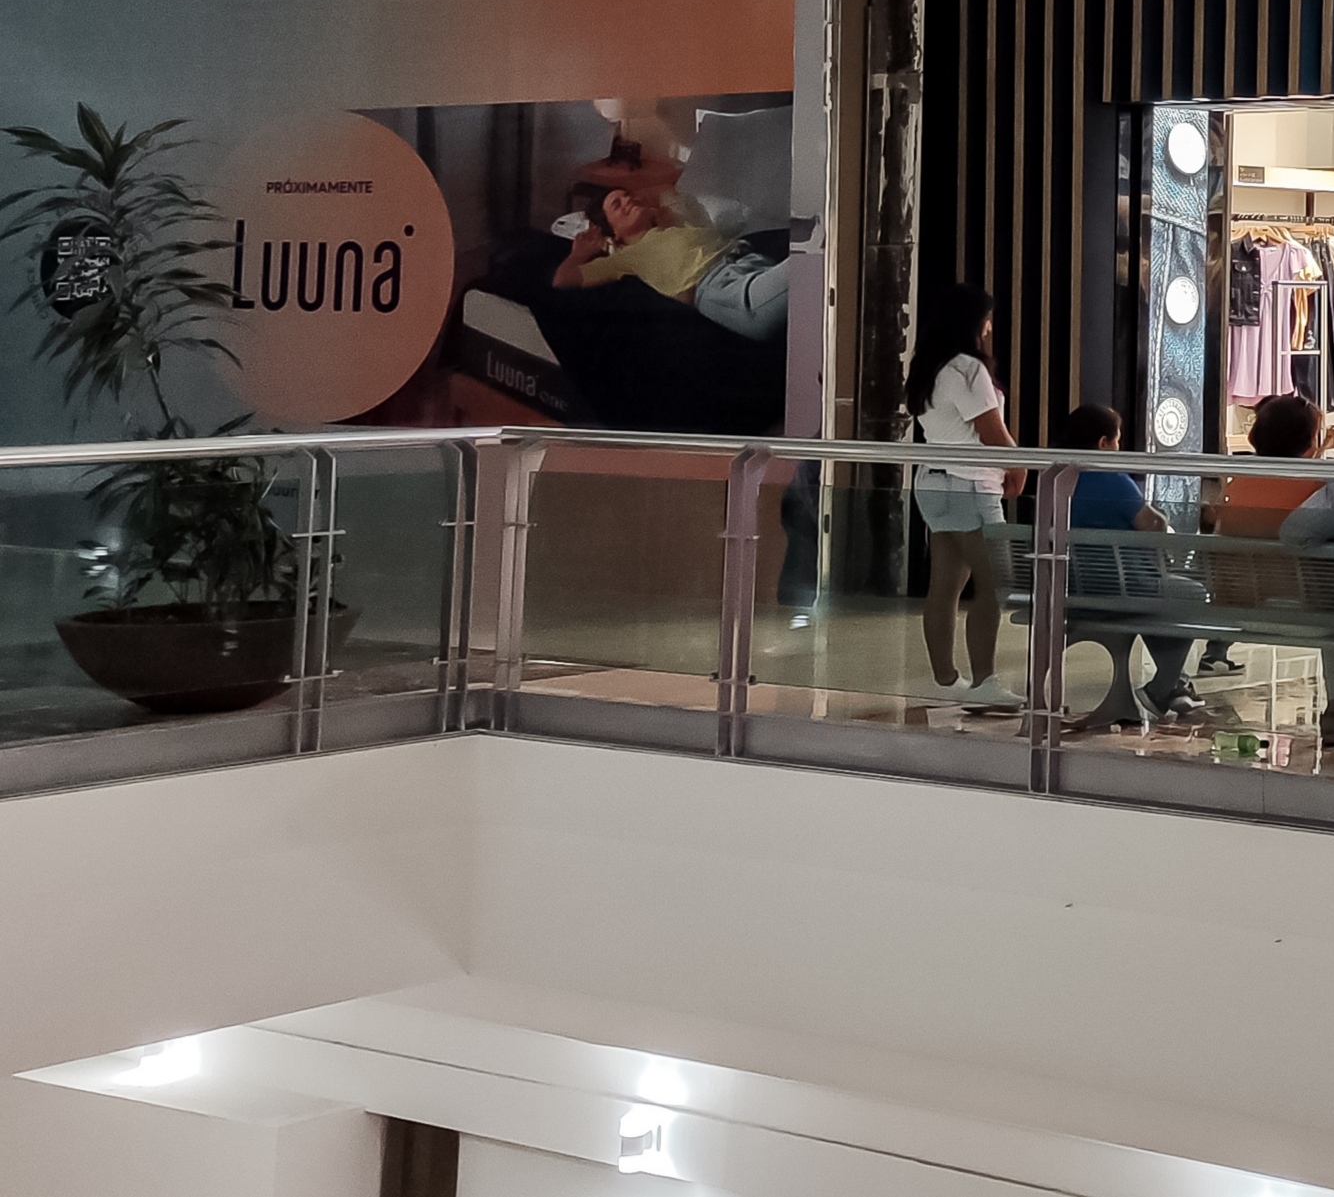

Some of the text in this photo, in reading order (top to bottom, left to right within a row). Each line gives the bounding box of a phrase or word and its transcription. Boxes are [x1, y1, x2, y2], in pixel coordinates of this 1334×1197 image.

[266, 178, 374, 194] PRÓXIMAMENTE
[231, 219, 402, 314] Luuna
[486, 350, 538, 397] Luuna
